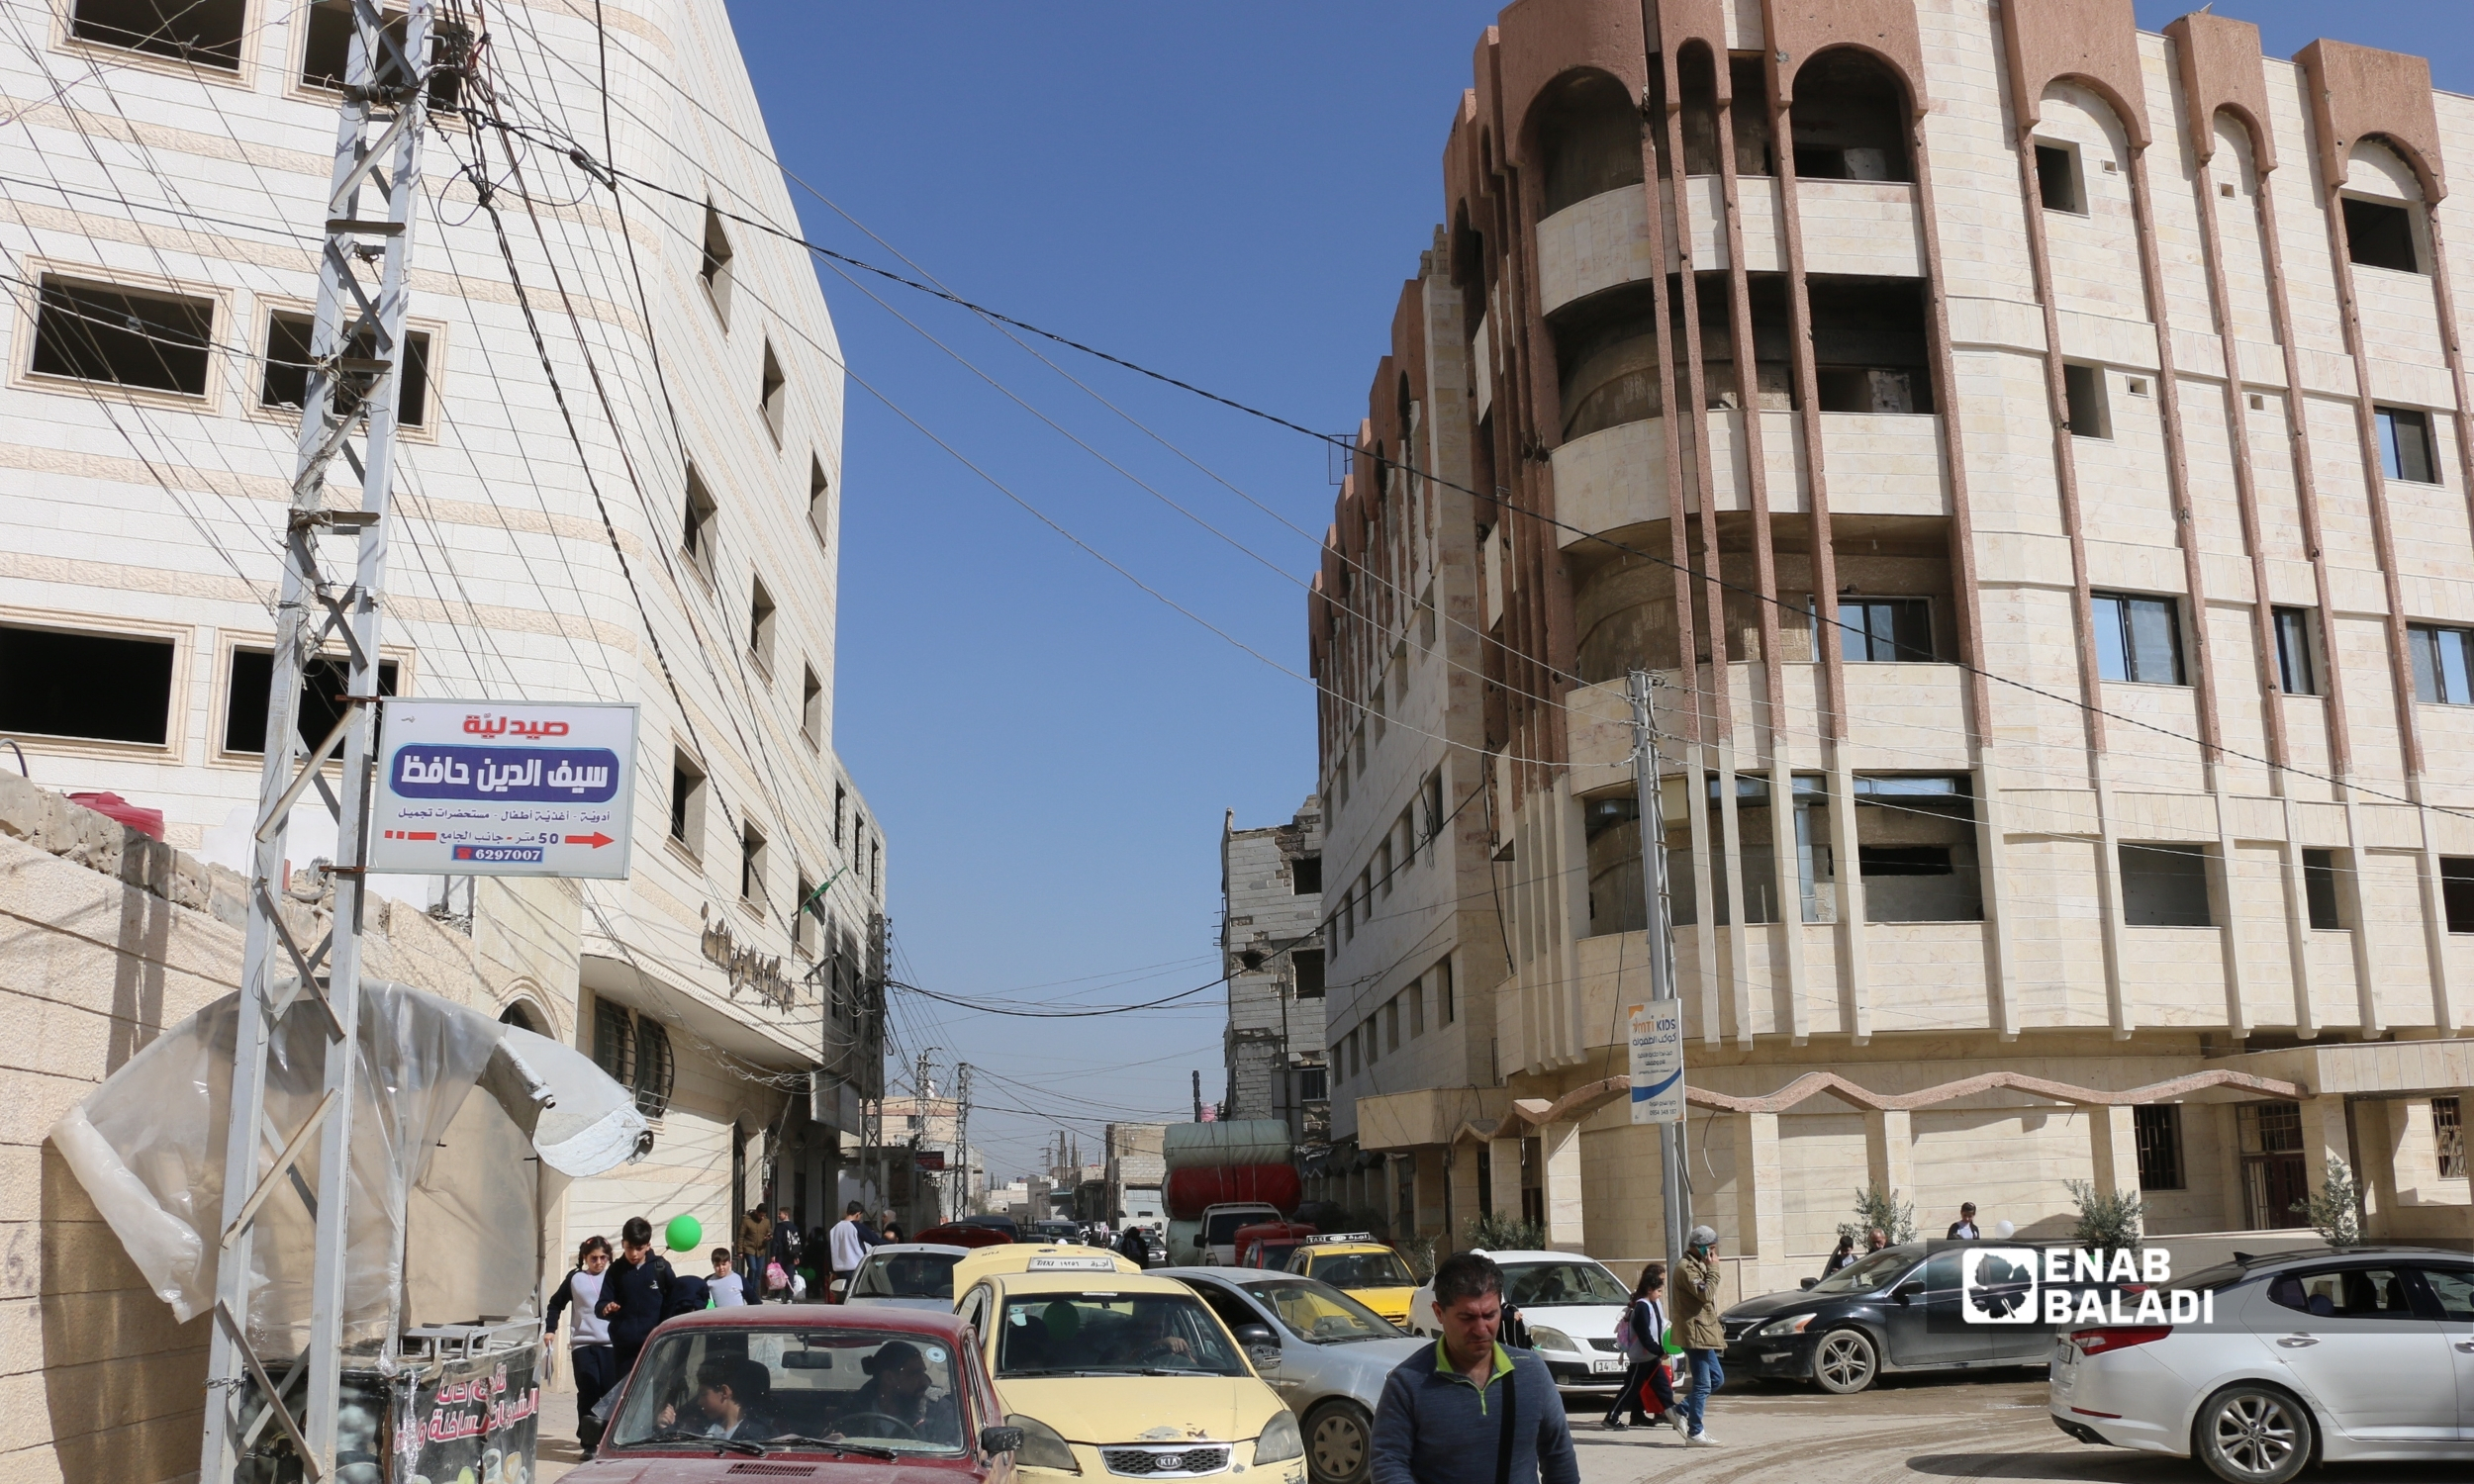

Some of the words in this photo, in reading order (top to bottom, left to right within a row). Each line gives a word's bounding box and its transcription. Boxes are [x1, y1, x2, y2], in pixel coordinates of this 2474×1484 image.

[401, 754, 470, 785] حافظ
[476, 758, 542, 792] الدين
[547, 759, 608, 793] سيف
[398, 807, 432, 818] تجميل
[435, 807, 490, 820] مستحضرات
[501, 809, 532, 822] أطفال
[439, 830, 472, 844] الجامع
[474, 831, 504, 844] جانب
[515, 832, 535, 844] متر
[538, 832, 559, 844] 50
[475, 848, 541, 861] 6297007
[1658, 1032, 1676, 1044] كوكب
[1160, 1457, 1178, 1466] KIA
